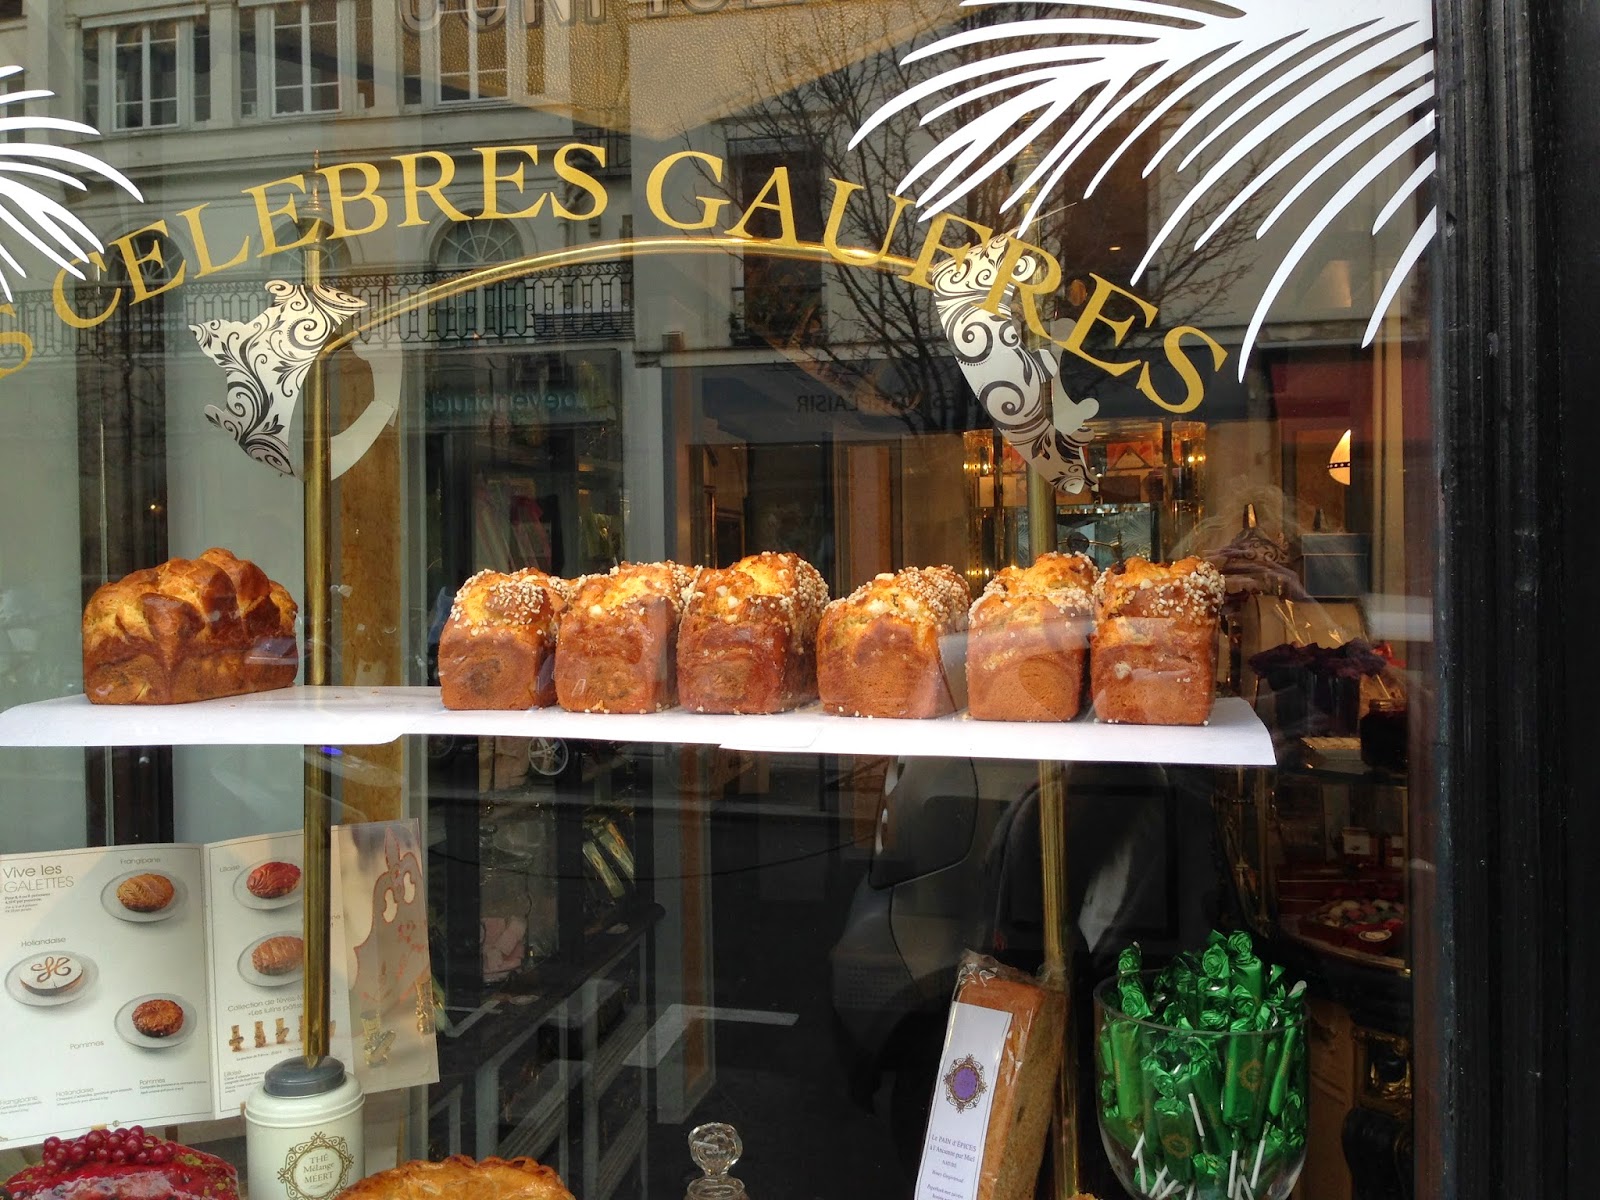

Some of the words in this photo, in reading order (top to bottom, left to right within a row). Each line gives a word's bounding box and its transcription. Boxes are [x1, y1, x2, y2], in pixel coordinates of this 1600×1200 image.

[52, 142, 608, 329] CELEBRES
[645, 151, 1228, 415] GAUFRES
[2, 866, 36, 879] Vive
[40, 864, 63, 876] les
[3, 875, 75, 893] GALETTES
[21, 937, 66, 947] Hollandaise
[228, 1002, 263, 1012] Collection
[70, 1039, 105, 1050] Pommes
[310, 1153, 329, 1164] THÉ
[303, 1162, 335, 1173] Mélange
